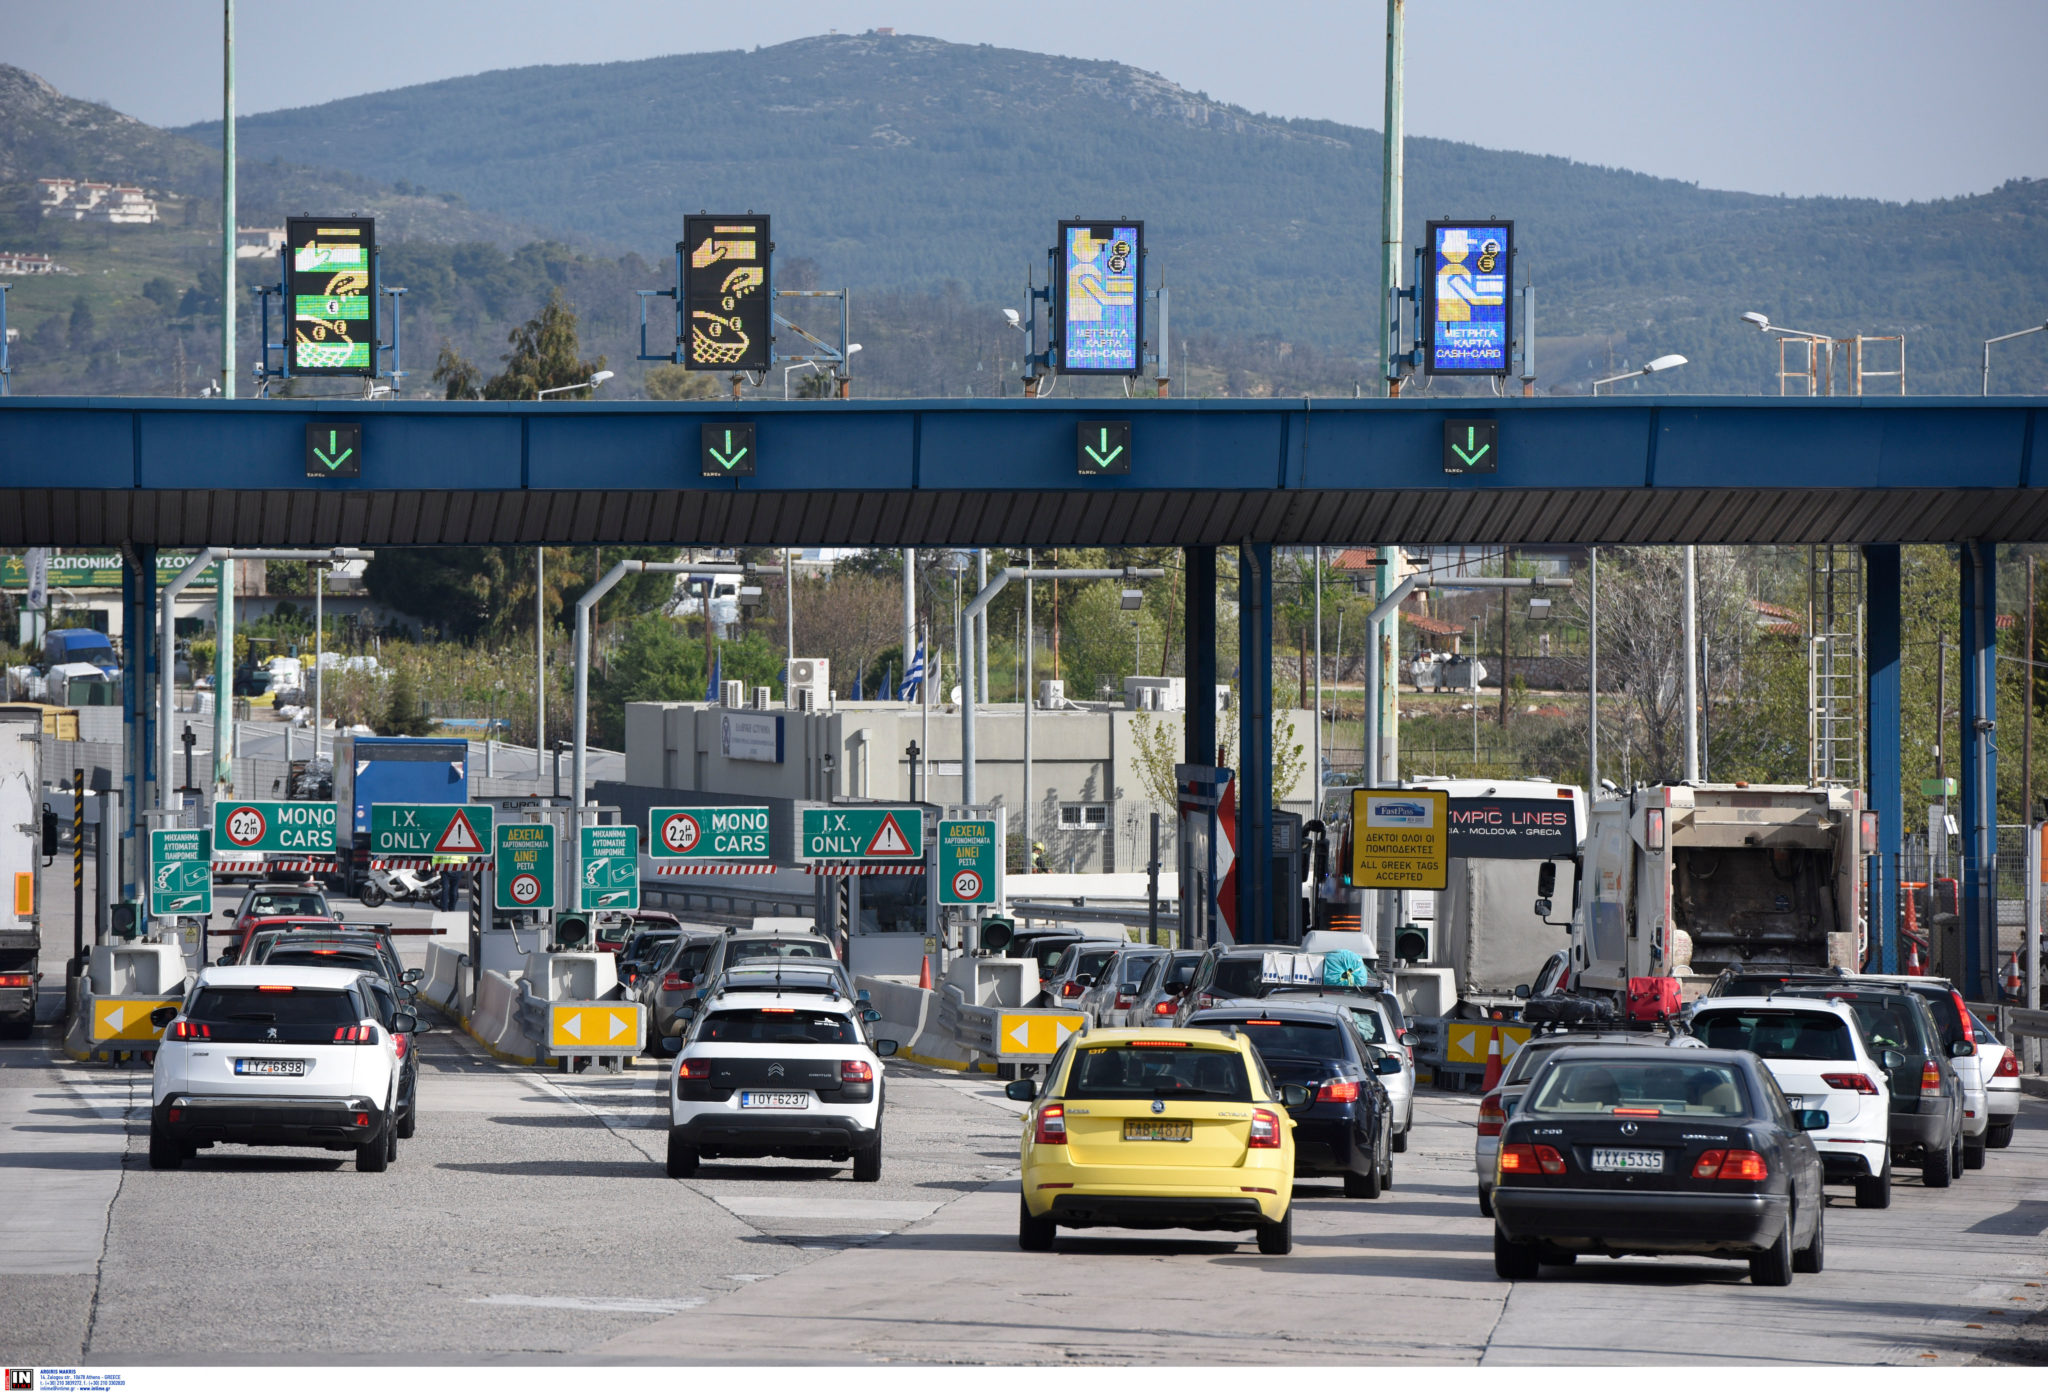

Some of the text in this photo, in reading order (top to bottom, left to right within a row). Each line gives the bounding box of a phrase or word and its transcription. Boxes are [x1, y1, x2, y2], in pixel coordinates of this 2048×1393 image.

[1444, 328, 1498, 338] ΜΕΤΡΗΤΑ
[1453, 339, 1492, 348] ΚΑΡΤΑ
[47, 556, 123, 569] ΕΩΠΟΝΙΚΑ
[156, 556, 196, 569] ΥΣΟΥ
[278, 807, 336, 825] MONO
[1381, 807, 1414, 816] FastPass
[392, 810, 421, 827] I.X.
[711, 813, 768, 831] MONO
[823, 814, 851, 831] I.X.
[1449, 811, 1567, 825] MPIC LINES
[234, 819, 251, 835] 2.2
[669, 823, 686, 842] 2.2
[949, 825, 985, 837] ΔΕΧΕΤΑΙ
[1469, 827, 1517, 835] MOLDOVA
[1525, 828, 1562, 836] GRECIA
[279, 830, 333, 847] CARS
[507, 829, 544, 841] ΔΕΧΕΤΑΙ
[592, 830, 627, 838] ΜΗΧΑΝΗΜΑ
[1366, 833, 1435, 843] ΔΕΚΤΟΙ ΟΛΟΙ ΟΙ
[164, 842, 200, 851] ΑΥΤΟΜΑΤΗΣ
[380, 832, 431, 849] ONLY
[592, 839, 627, 847] ΑΥΤΟΜΑΤΗΣ
[714, 835, 767, 853] CARS
[812, 837, 862, 853] ONLY
[955, 846, 980, 858] ΔΙΝΕΙ
[1366, 844, 1433, 854] ΠΟΜΠΟΔΕΚΤΕΣ
[513, 850, 538, 862] ΔΙΝΕΙ
[958, 858, 977, 866] ΡΕΣΤΑ
[516, 862, 535, 871] ΡΕΣΤΑ
[1360, 861, 1439, 870] ALL GREEK TAGS
[1376, 872, 1423, 882] ACCEPTED
[516, 883, 535, 895] 20
[958, 879, 976, 891] 20
